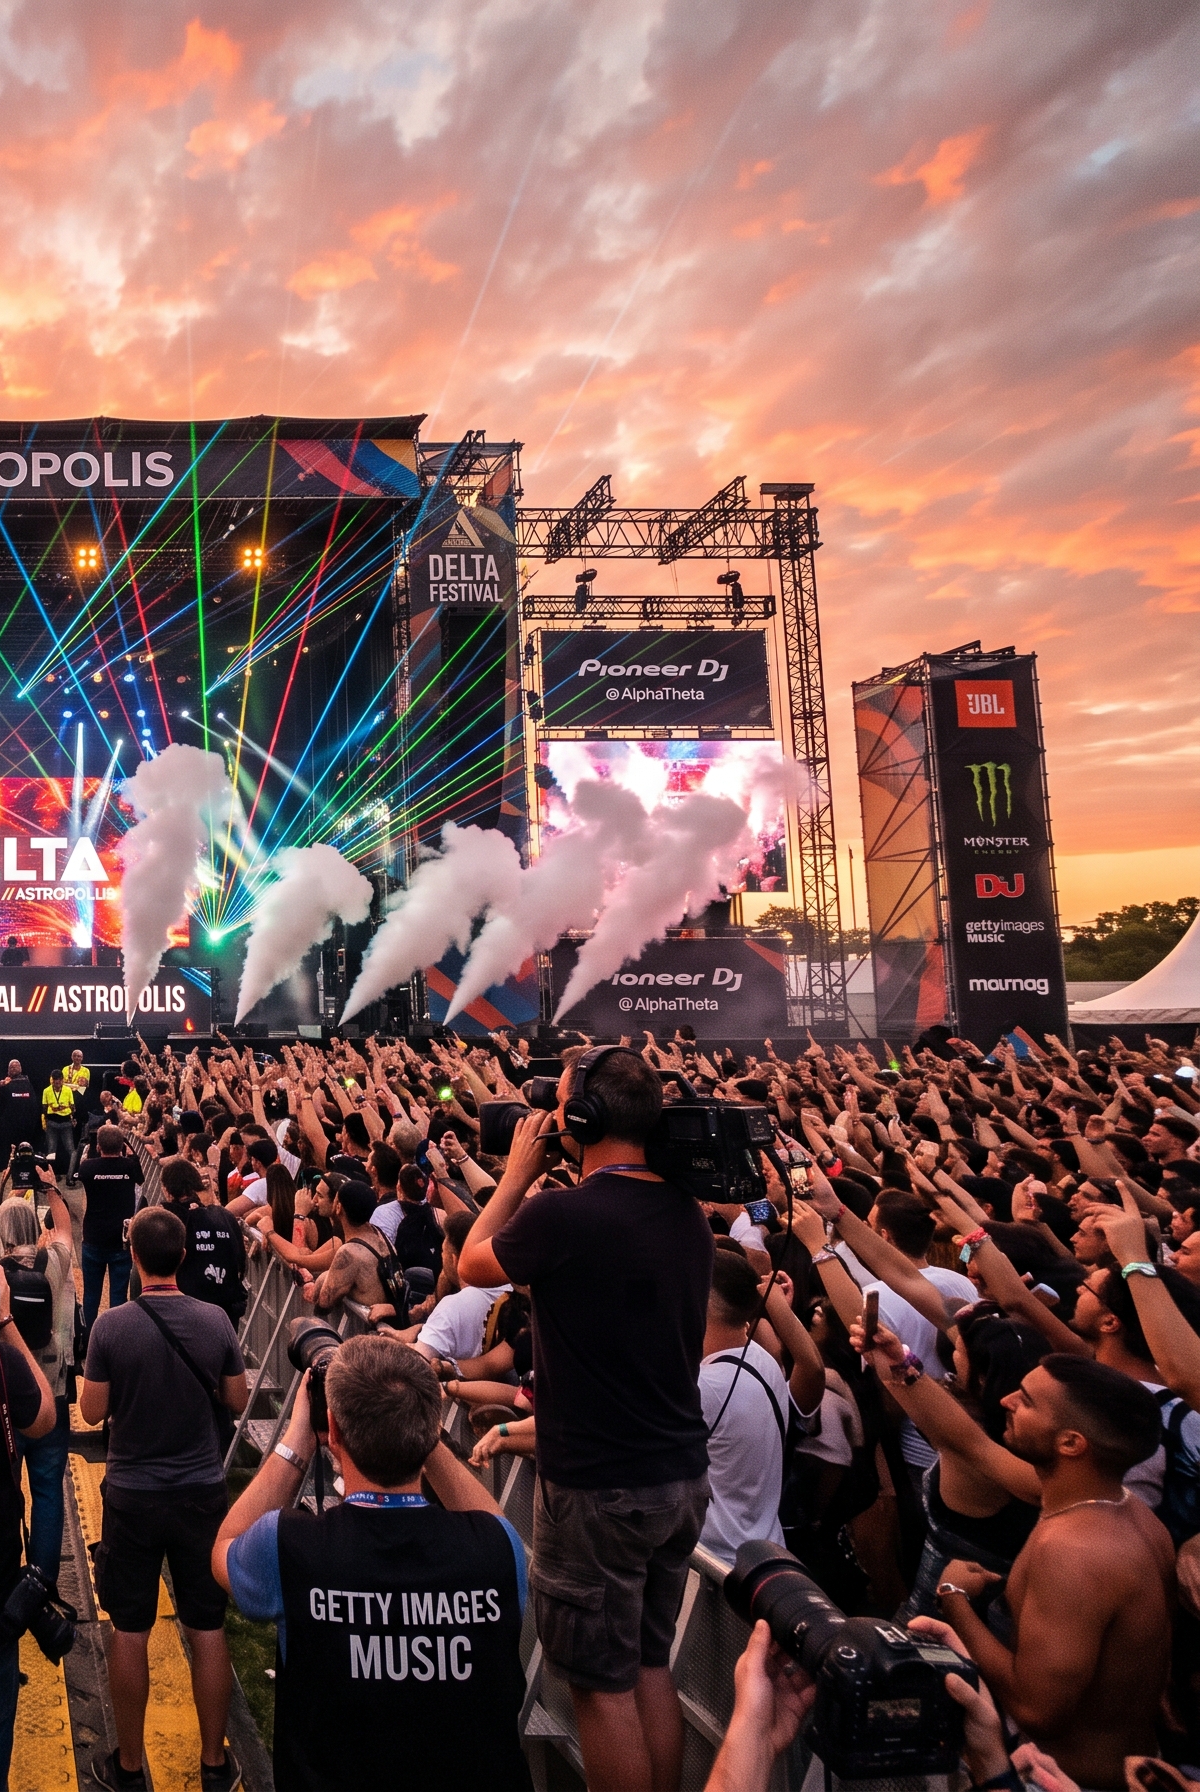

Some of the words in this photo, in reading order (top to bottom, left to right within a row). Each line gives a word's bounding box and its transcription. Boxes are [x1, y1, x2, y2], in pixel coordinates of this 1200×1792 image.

[429, 554, 501, 582] DELTA
[430, 584, 504, 602] FESTIVAL
[578, 659, 692, 677] Pioneer
[966, 693, 1005, 715] JBL
[963, 836, 1030, 847] MONSTER
[966, 919, 1045, 934] gettyimages
[967, 934, 1005, 943] MUSIC
[611, 973, 705, 986] ioneer
[309, 1587, 393, 1625] GETTY
[401, 1588, 501, 1625] IMAGES
[350, 1634, 473, 1681] MUSIC
